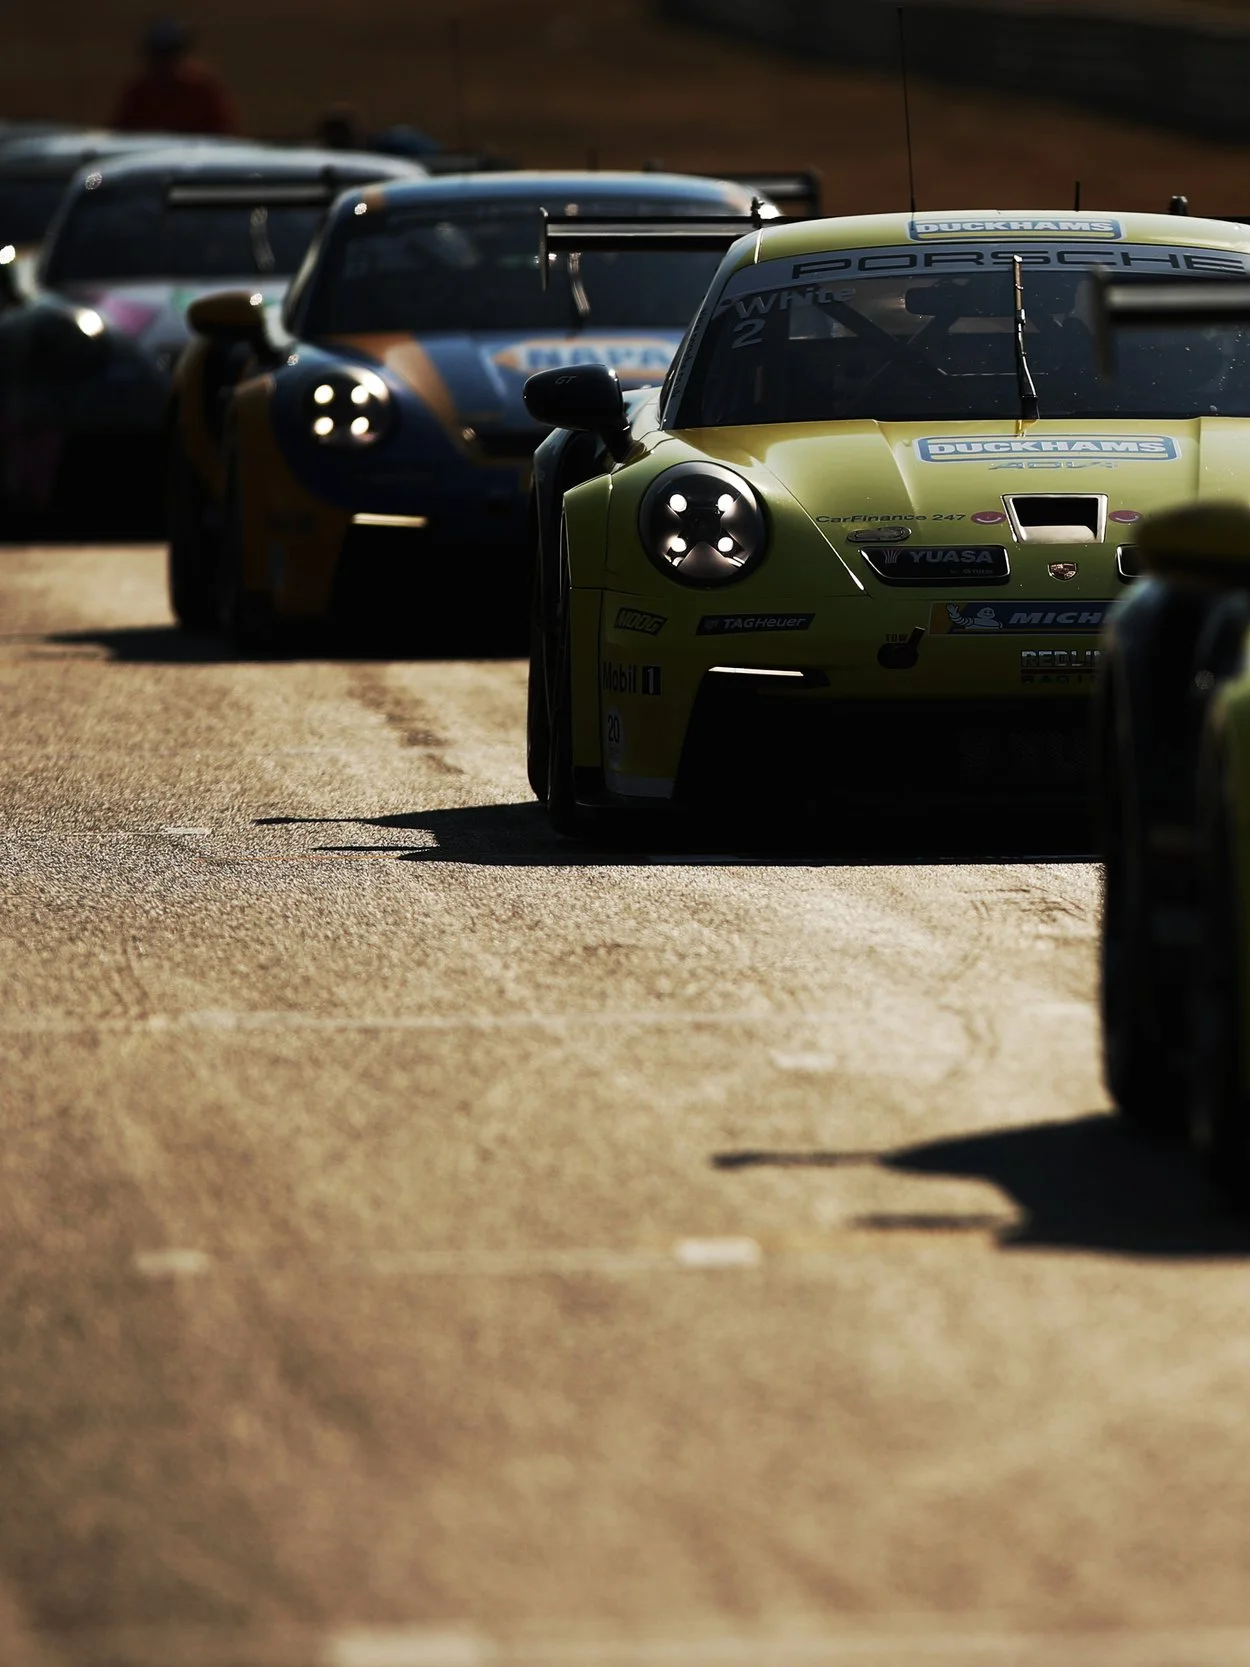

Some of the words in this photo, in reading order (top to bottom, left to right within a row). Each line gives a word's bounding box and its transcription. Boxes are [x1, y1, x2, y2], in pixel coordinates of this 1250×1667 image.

[916, 220, 1114, 233] DUCKHAMS
[792, 250, 1246, 279] PORSCHE
[731, 318, 766, 350] 2
[554, 375, 577, 385] GT
[929, 440, 1166, 454] DUCKHAMS
[815, 514, 926, 524] CarFinance
[932, 514, 965, 523] 247
[909, 550, 994, 565] YUASA
[617, 609, 664, 633] MOOG
[1009, 612, 1108, 624] MICH
[885, 633, 907, 642] TOW
[602, 661, 637, 693] Mobil
[607, 714, 620, 743] 20
